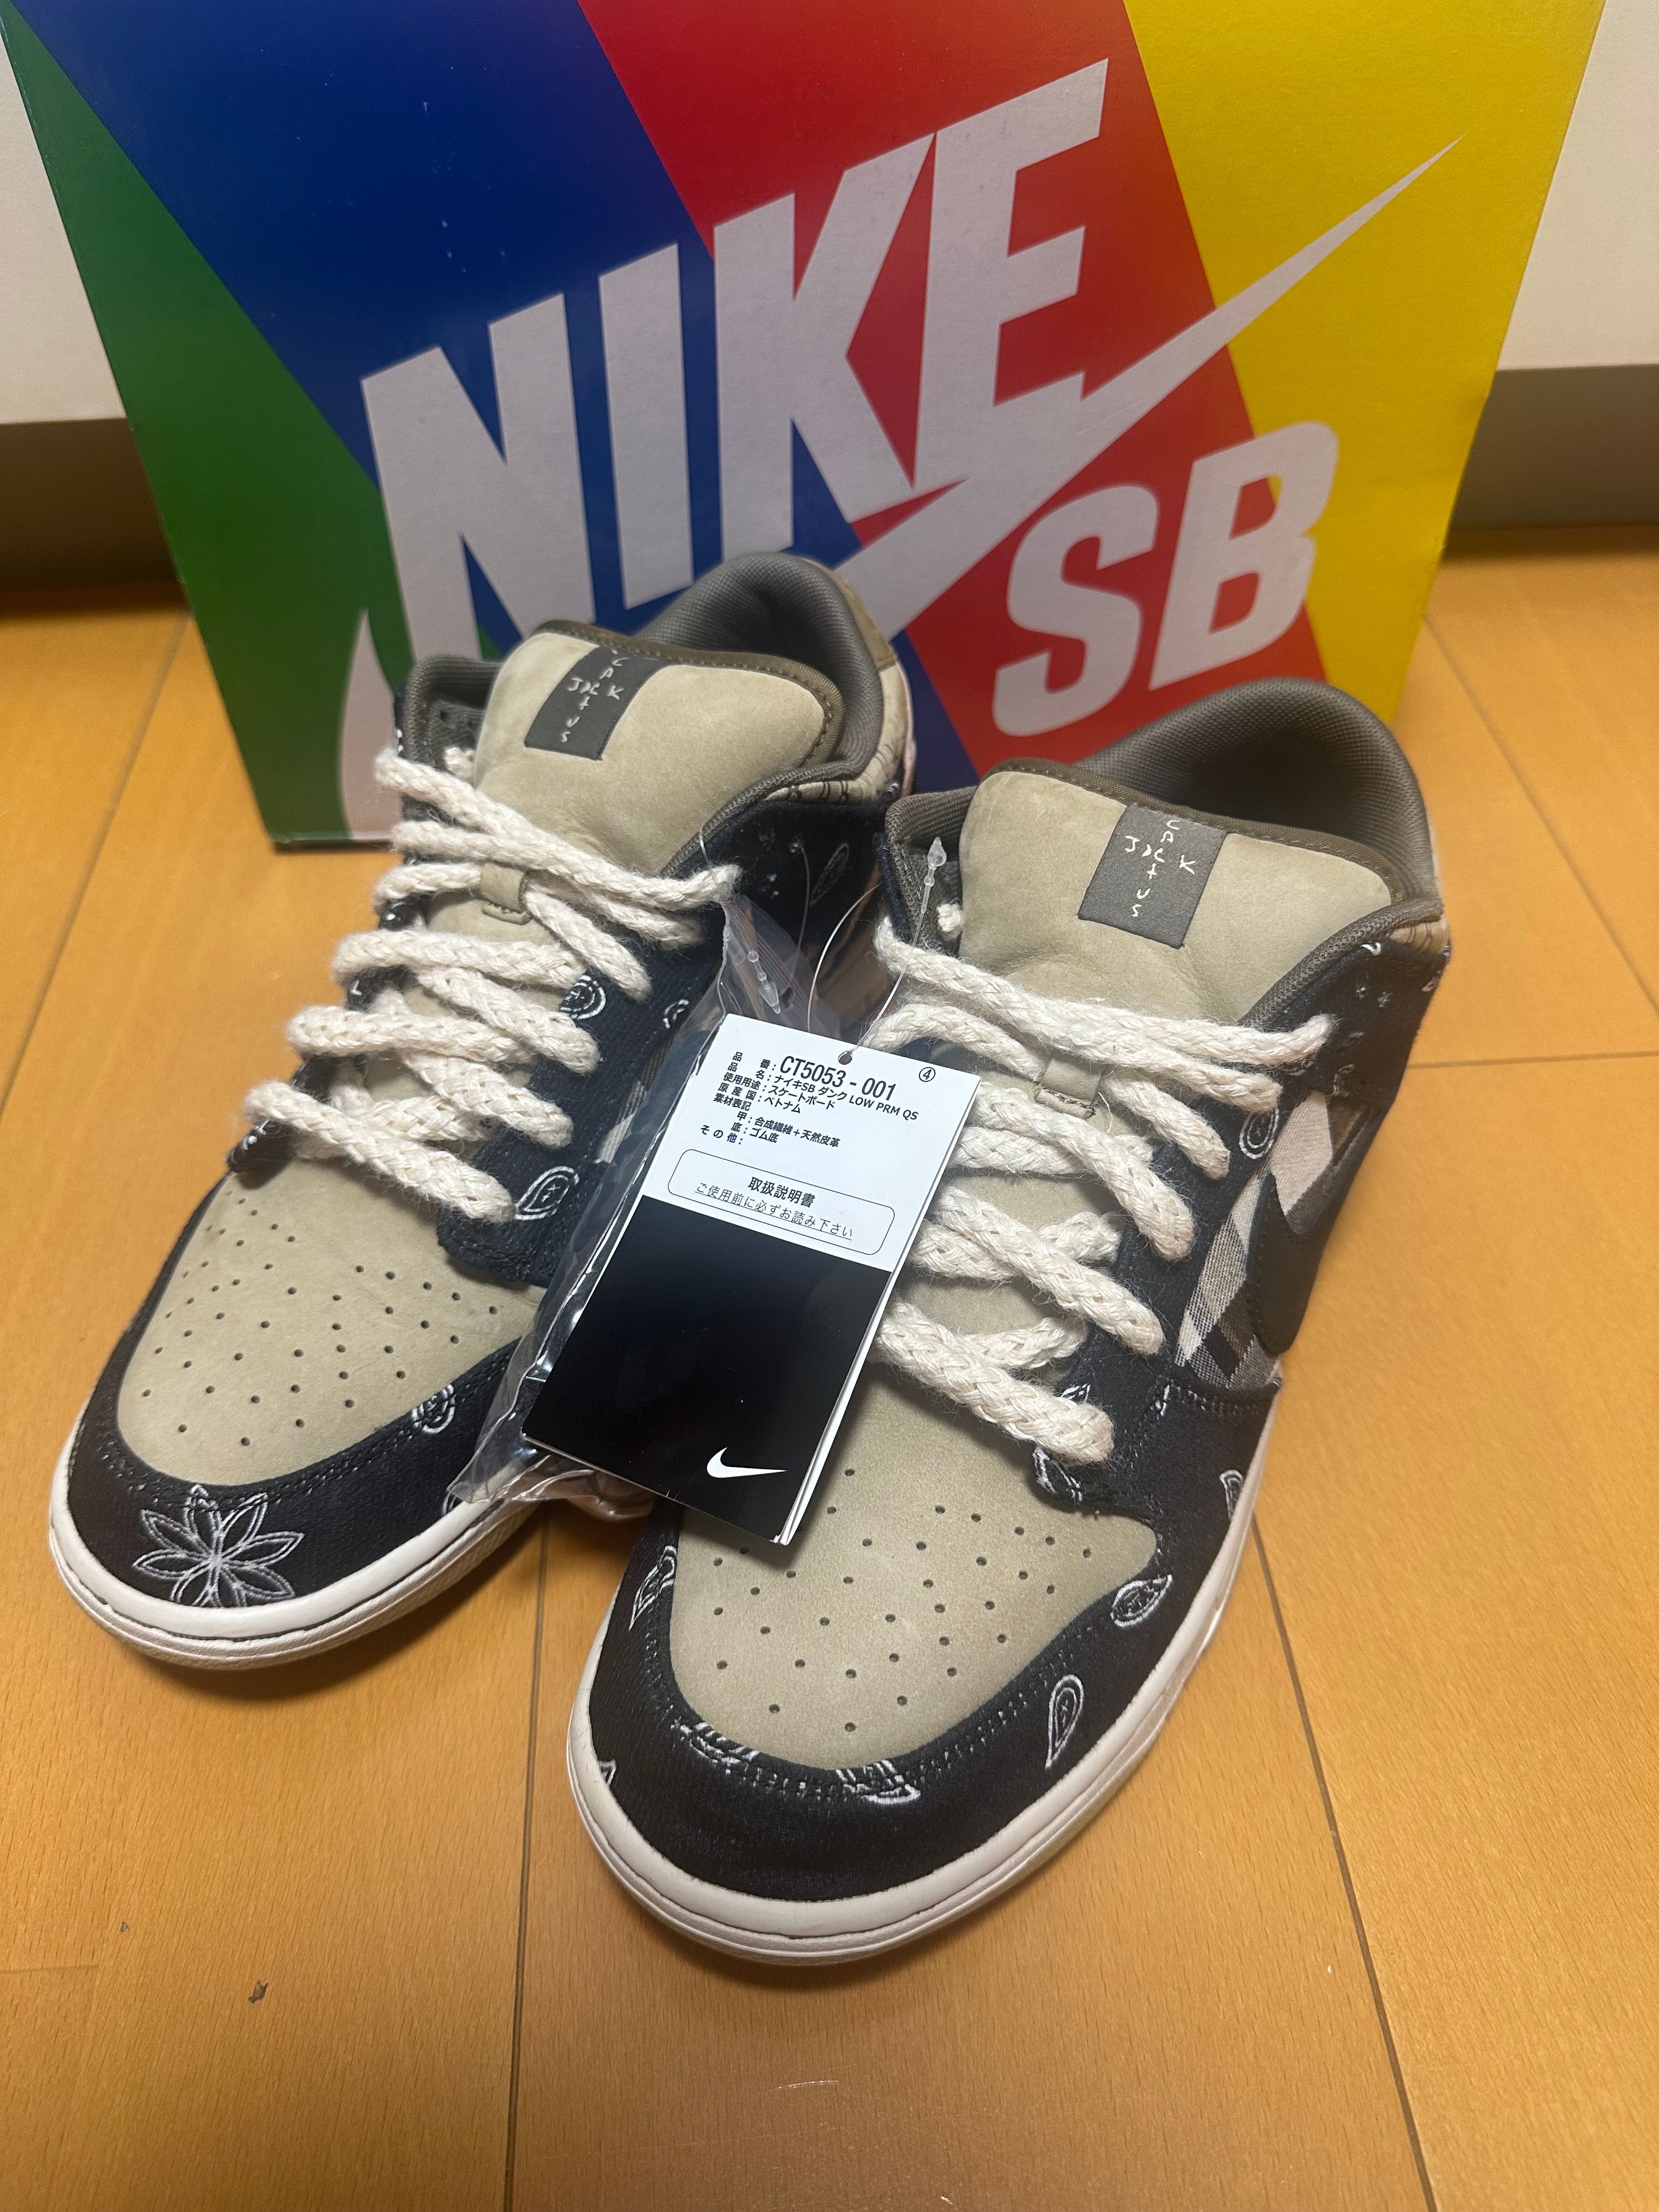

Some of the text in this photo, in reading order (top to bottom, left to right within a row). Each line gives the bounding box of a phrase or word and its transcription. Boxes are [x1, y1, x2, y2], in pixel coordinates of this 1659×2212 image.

[360, 58, 1109, 663] NIKE
[992, 421, 1339, 736] SB
[713, 1093, 751, 1111] 素材表記
[849, 1095, 873, 1109] LOW
[876, 1103, 901, 1116] PRM
[902, 1109, 919, 1121] QS
[696, 1183, 853, 1237] ご使用前に必ずお読み下さい
[748, 1177, 815, 1207] 取扱説明書
